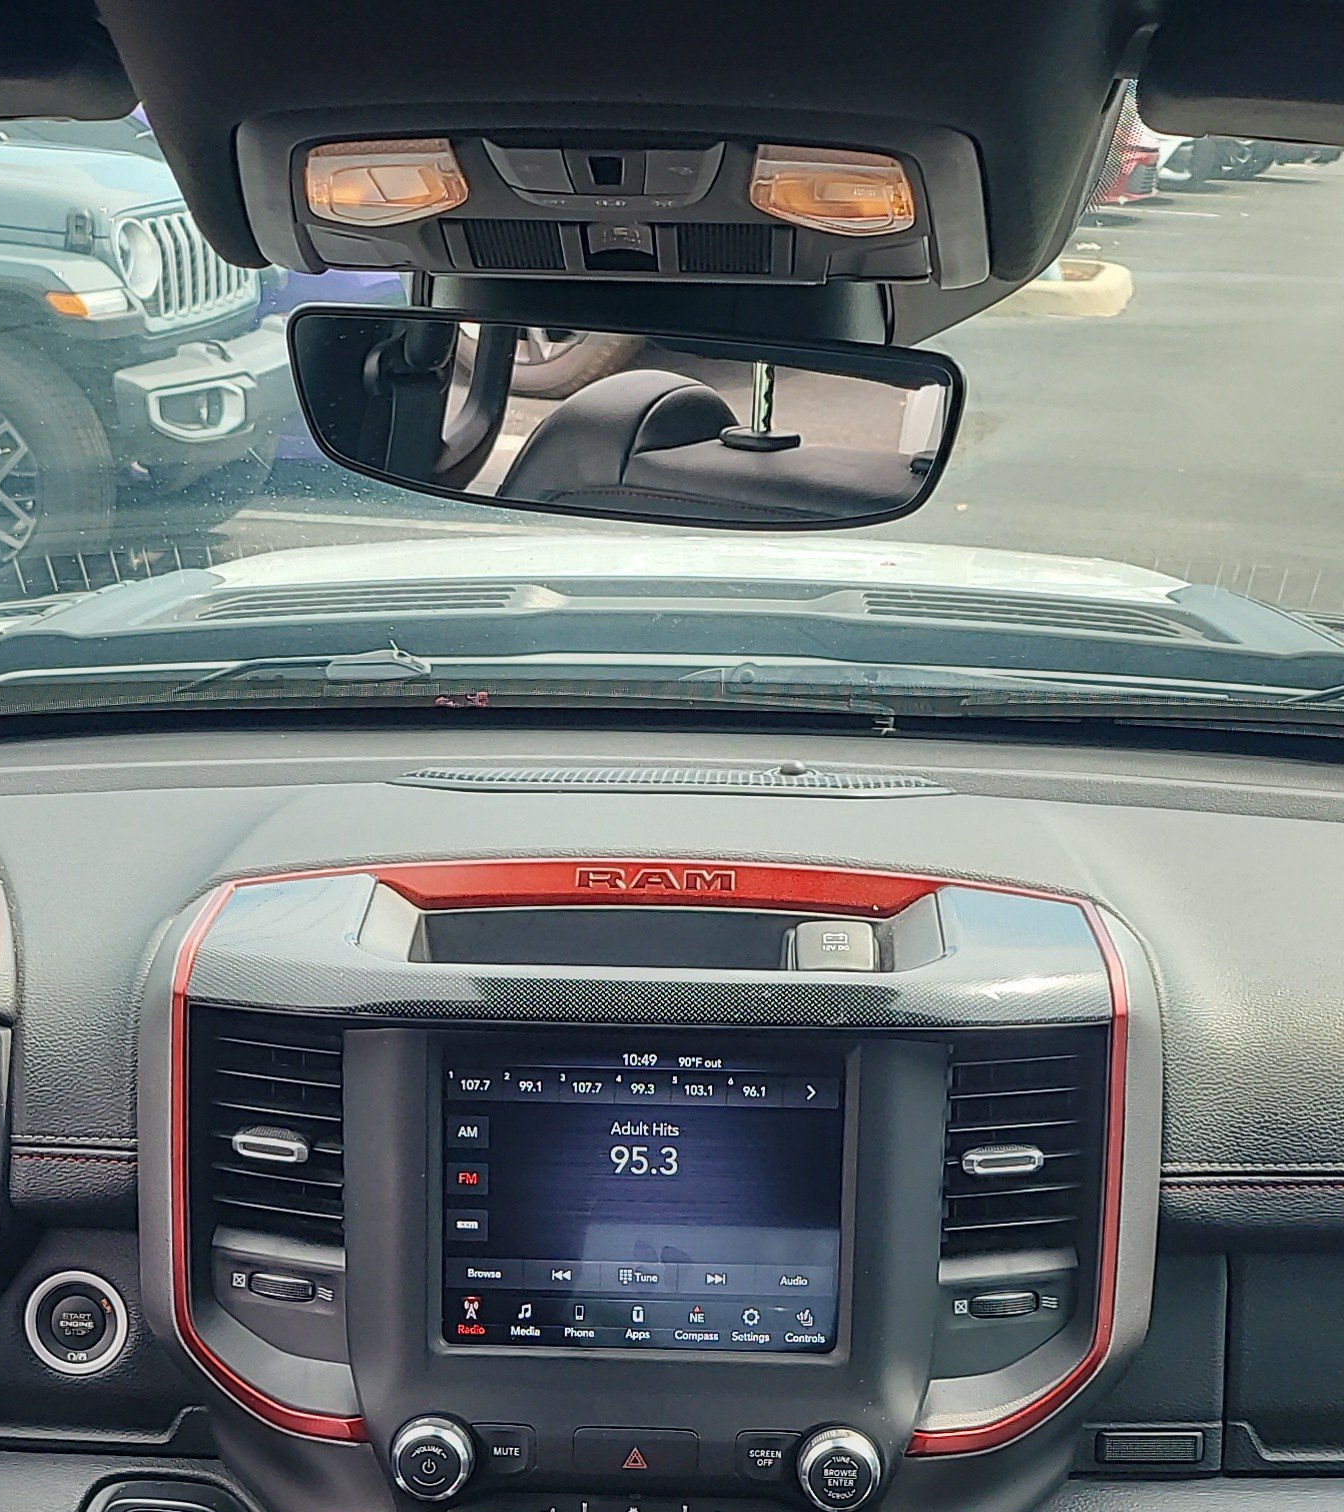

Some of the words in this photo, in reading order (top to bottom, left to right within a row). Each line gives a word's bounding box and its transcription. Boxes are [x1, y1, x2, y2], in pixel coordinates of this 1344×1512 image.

[575, 868, 736, 891] RAM
[622, 1053, 657, 1067] 10:49
[705, 1058, 722, 1068] out
[461, 1079, 490, 1092] 107.7
[519, 1080, 542, 1093] 99.1
[572, 1081, 602, 1094] 107.7
[631, 1083, 655, 1095] 99.3
[684, 1084, 714, 1096] 103.1
[743, 1085, 766, 1098] 96.1
[458, 1126, 478, 1138] AM
[610, 1121, 649, 1136] Adult
[652, 1122, 680, 1136] Hits
[610, 1146, 679, 1175] 95.3
[458, 1173, 479, 1185] FM
[467, 1268, 502, 1279] Browse
[634, 1272, 659, 1283] Tune
[780, 1275, 808, 1287] Audio
[689, 1312, 705, 1323] NE
[59, 1320, 94, 1328] ENGINE
[458, 1324, 485, 1335] Radio
[511, 1326, 540, 1337] Media
[564, 1328, 595, 1338] Phone
[625, 1329, 650, 1341] Apps
[675, 1330, 719, 1343] Compass
[731, 1331, 770, 1344] Settings
[785, 1332, 826, 1344] Controls
[492, 1445, 520, 1457] MUTE
[748, 1449, 782, 1460] SCREEN
[757, 1458, 773, 1468] OFF
[832, 1456, 851, 1464] TUNE
[827, 1490, 853, 1499] SCROLL
